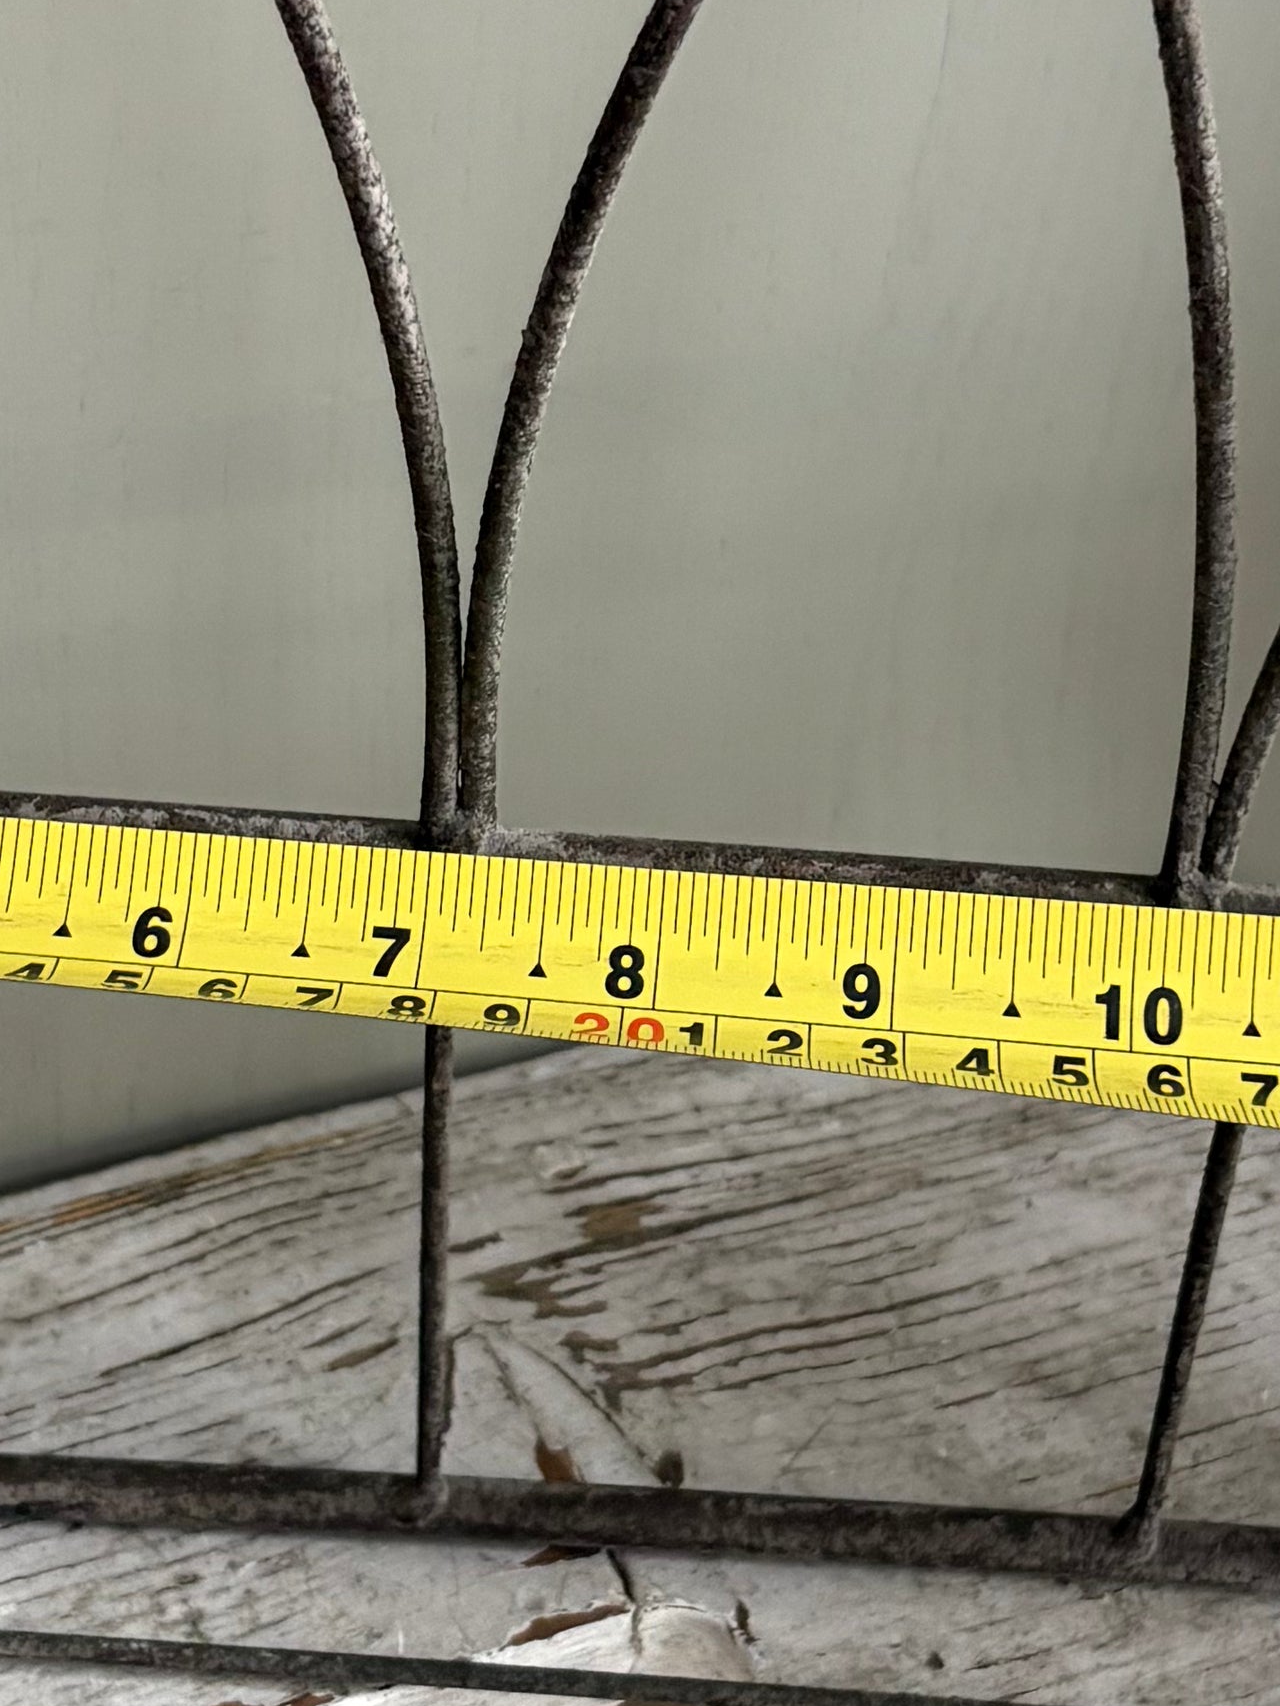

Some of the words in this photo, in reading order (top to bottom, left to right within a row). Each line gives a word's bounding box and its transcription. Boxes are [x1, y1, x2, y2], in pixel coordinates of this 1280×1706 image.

[5, 962, 46, 980] 4
[101, 970, 143, 989] 5
[198, 978, 238, 999] 6
[295, 986, 334, 1006] 7
[387, 995, 426, 1017] 8
[483, 1003, 520, 1026] 9
[574, 1012, 664, 1042] 20
[679, 1022, 704, 1046] 1
[767, 1029, 803, 1056] 2
[860, 1038, 898, 1066] 3
[956, 1047, 995, 1076] 4
[1051, 1055, 1089, 1086] 5
[1147, 1064, 1185, 1097] 6
[1241, 1072, 1279, 1106] 7
[132, 906, 173, 958] 6
[371, 926, 411, 977] 7
[605, 945, 645, 999] 8
[842, 963, 881, 1019] 9
[1095, 984, 1183, 1045] 10
